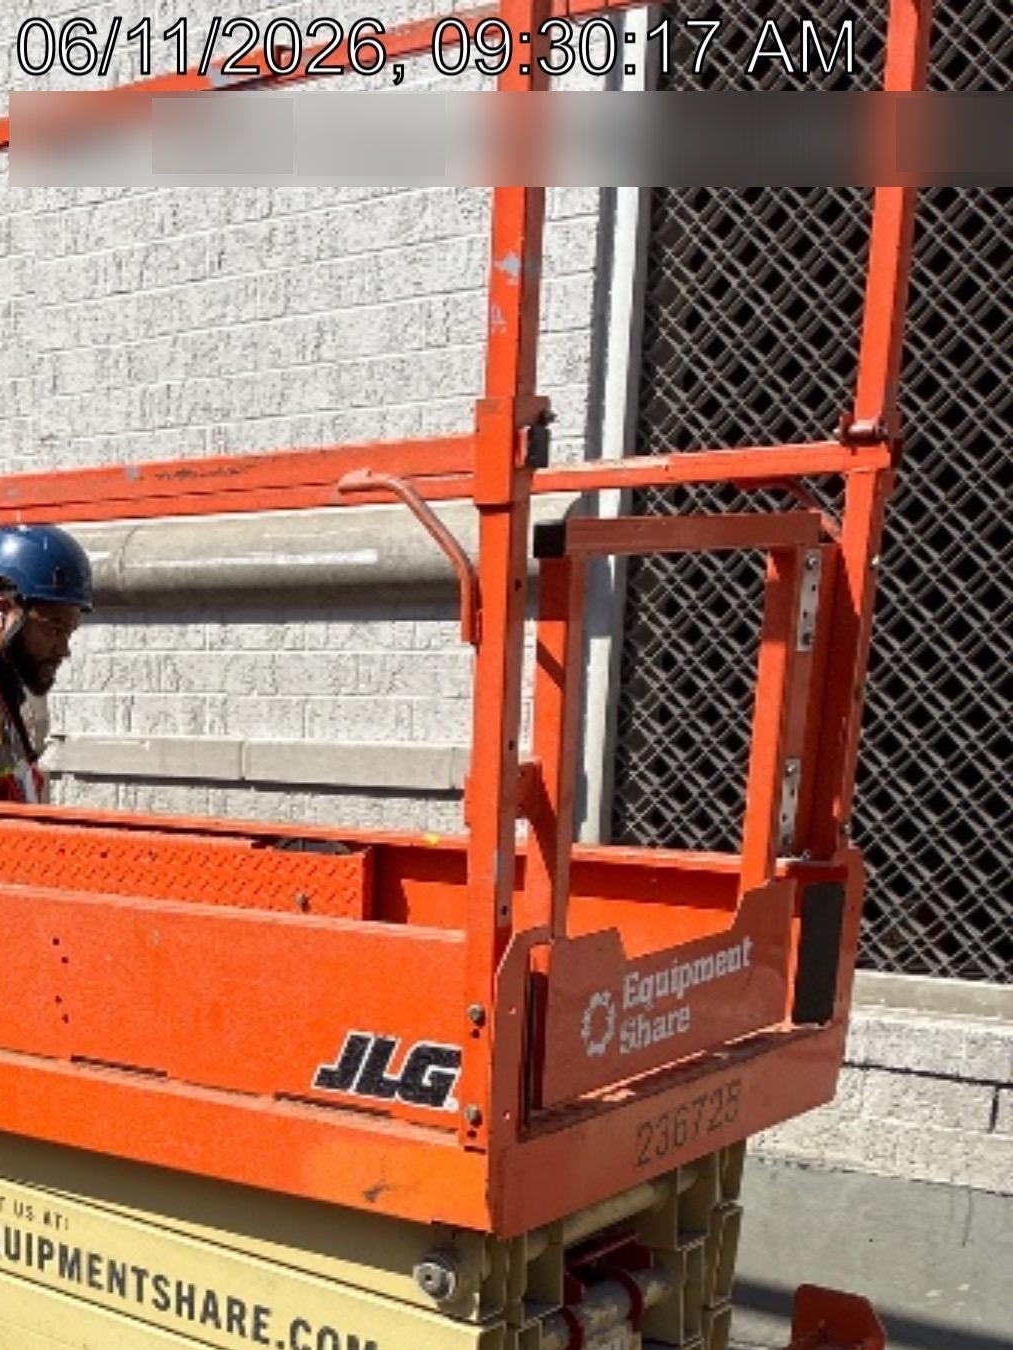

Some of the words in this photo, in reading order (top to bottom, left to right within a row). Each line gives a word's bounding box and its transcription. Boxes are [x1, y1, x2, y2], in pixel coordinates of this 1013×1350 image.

[622, 936, 753, 1010] Equipment
[619, 1006, 691, 1055] Share
[313, 1030, 463, 1111] JLG
[636, 1079, 742, 1172] 236725
[13, 1200, 35, 1222] US
